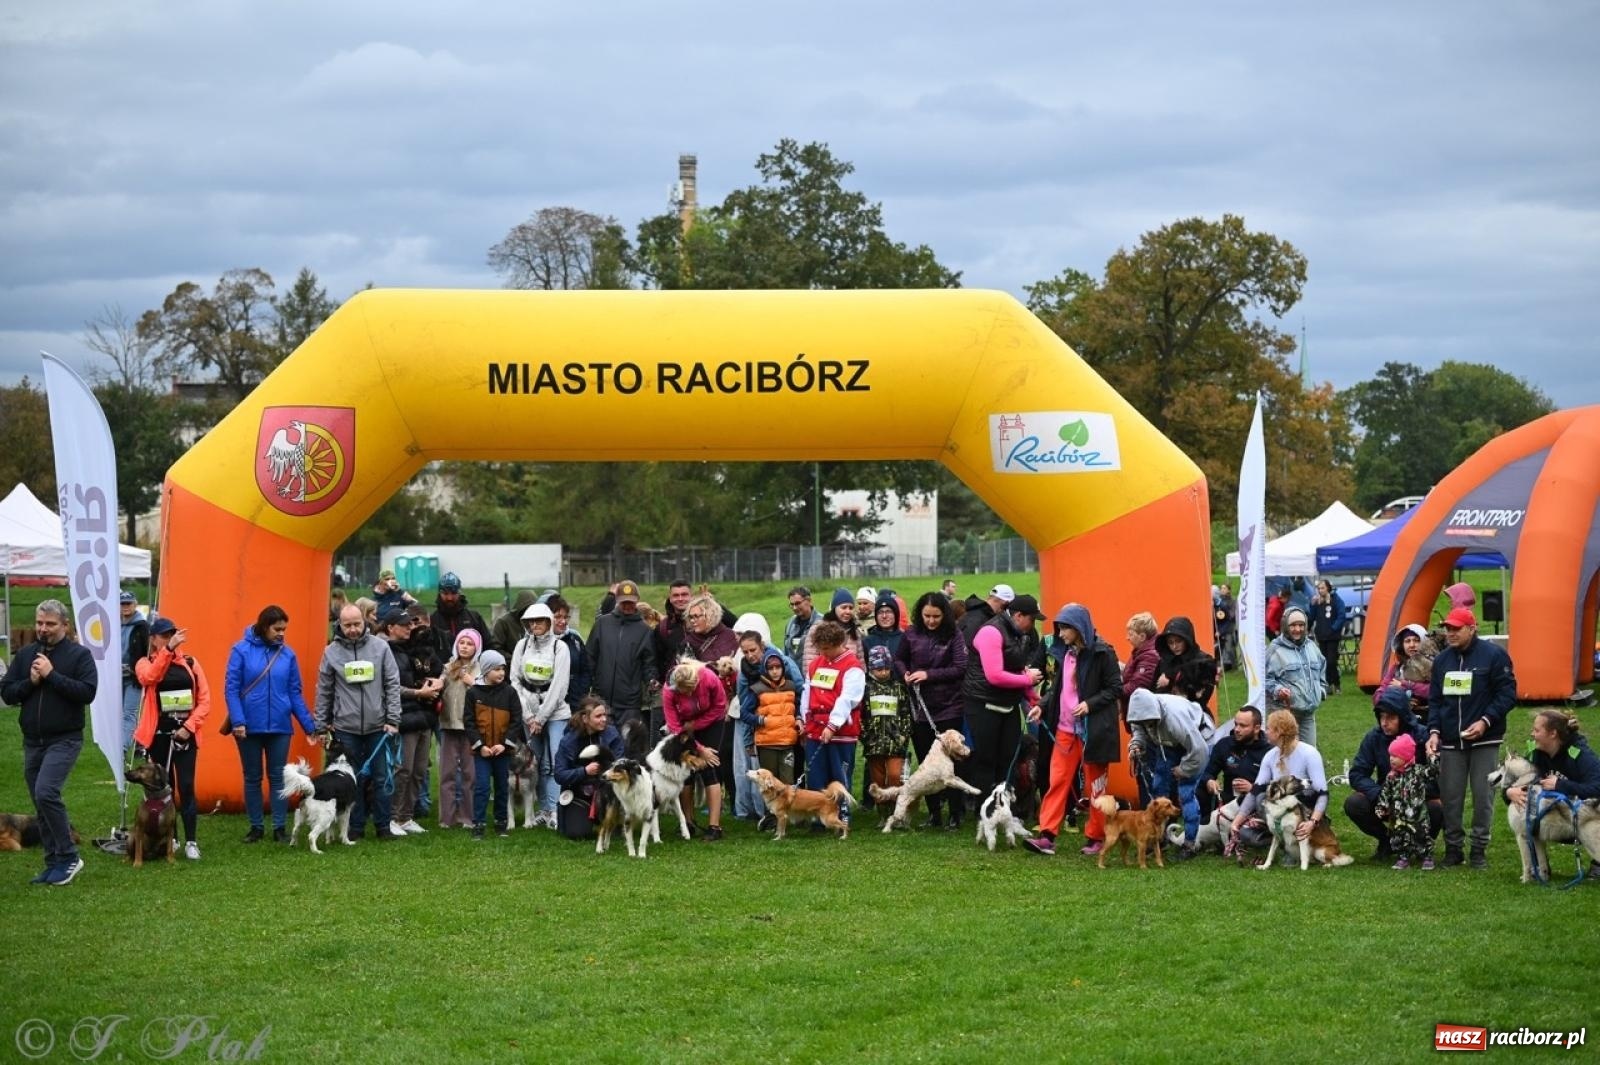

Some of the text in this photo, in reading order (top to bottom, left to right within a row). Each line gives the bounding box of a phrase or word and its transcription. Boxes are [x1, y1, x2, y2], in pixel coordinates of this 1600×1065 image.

[488, 353, 871, 394] MIASTO RACIBÓRZ
[1005, 436, 1112, 472] Racibórz
[1448, 509, 1522, 526] FRONTPRO
[1450, 679, 1462, 687] 96
[173, 696, 180, 705] 7
